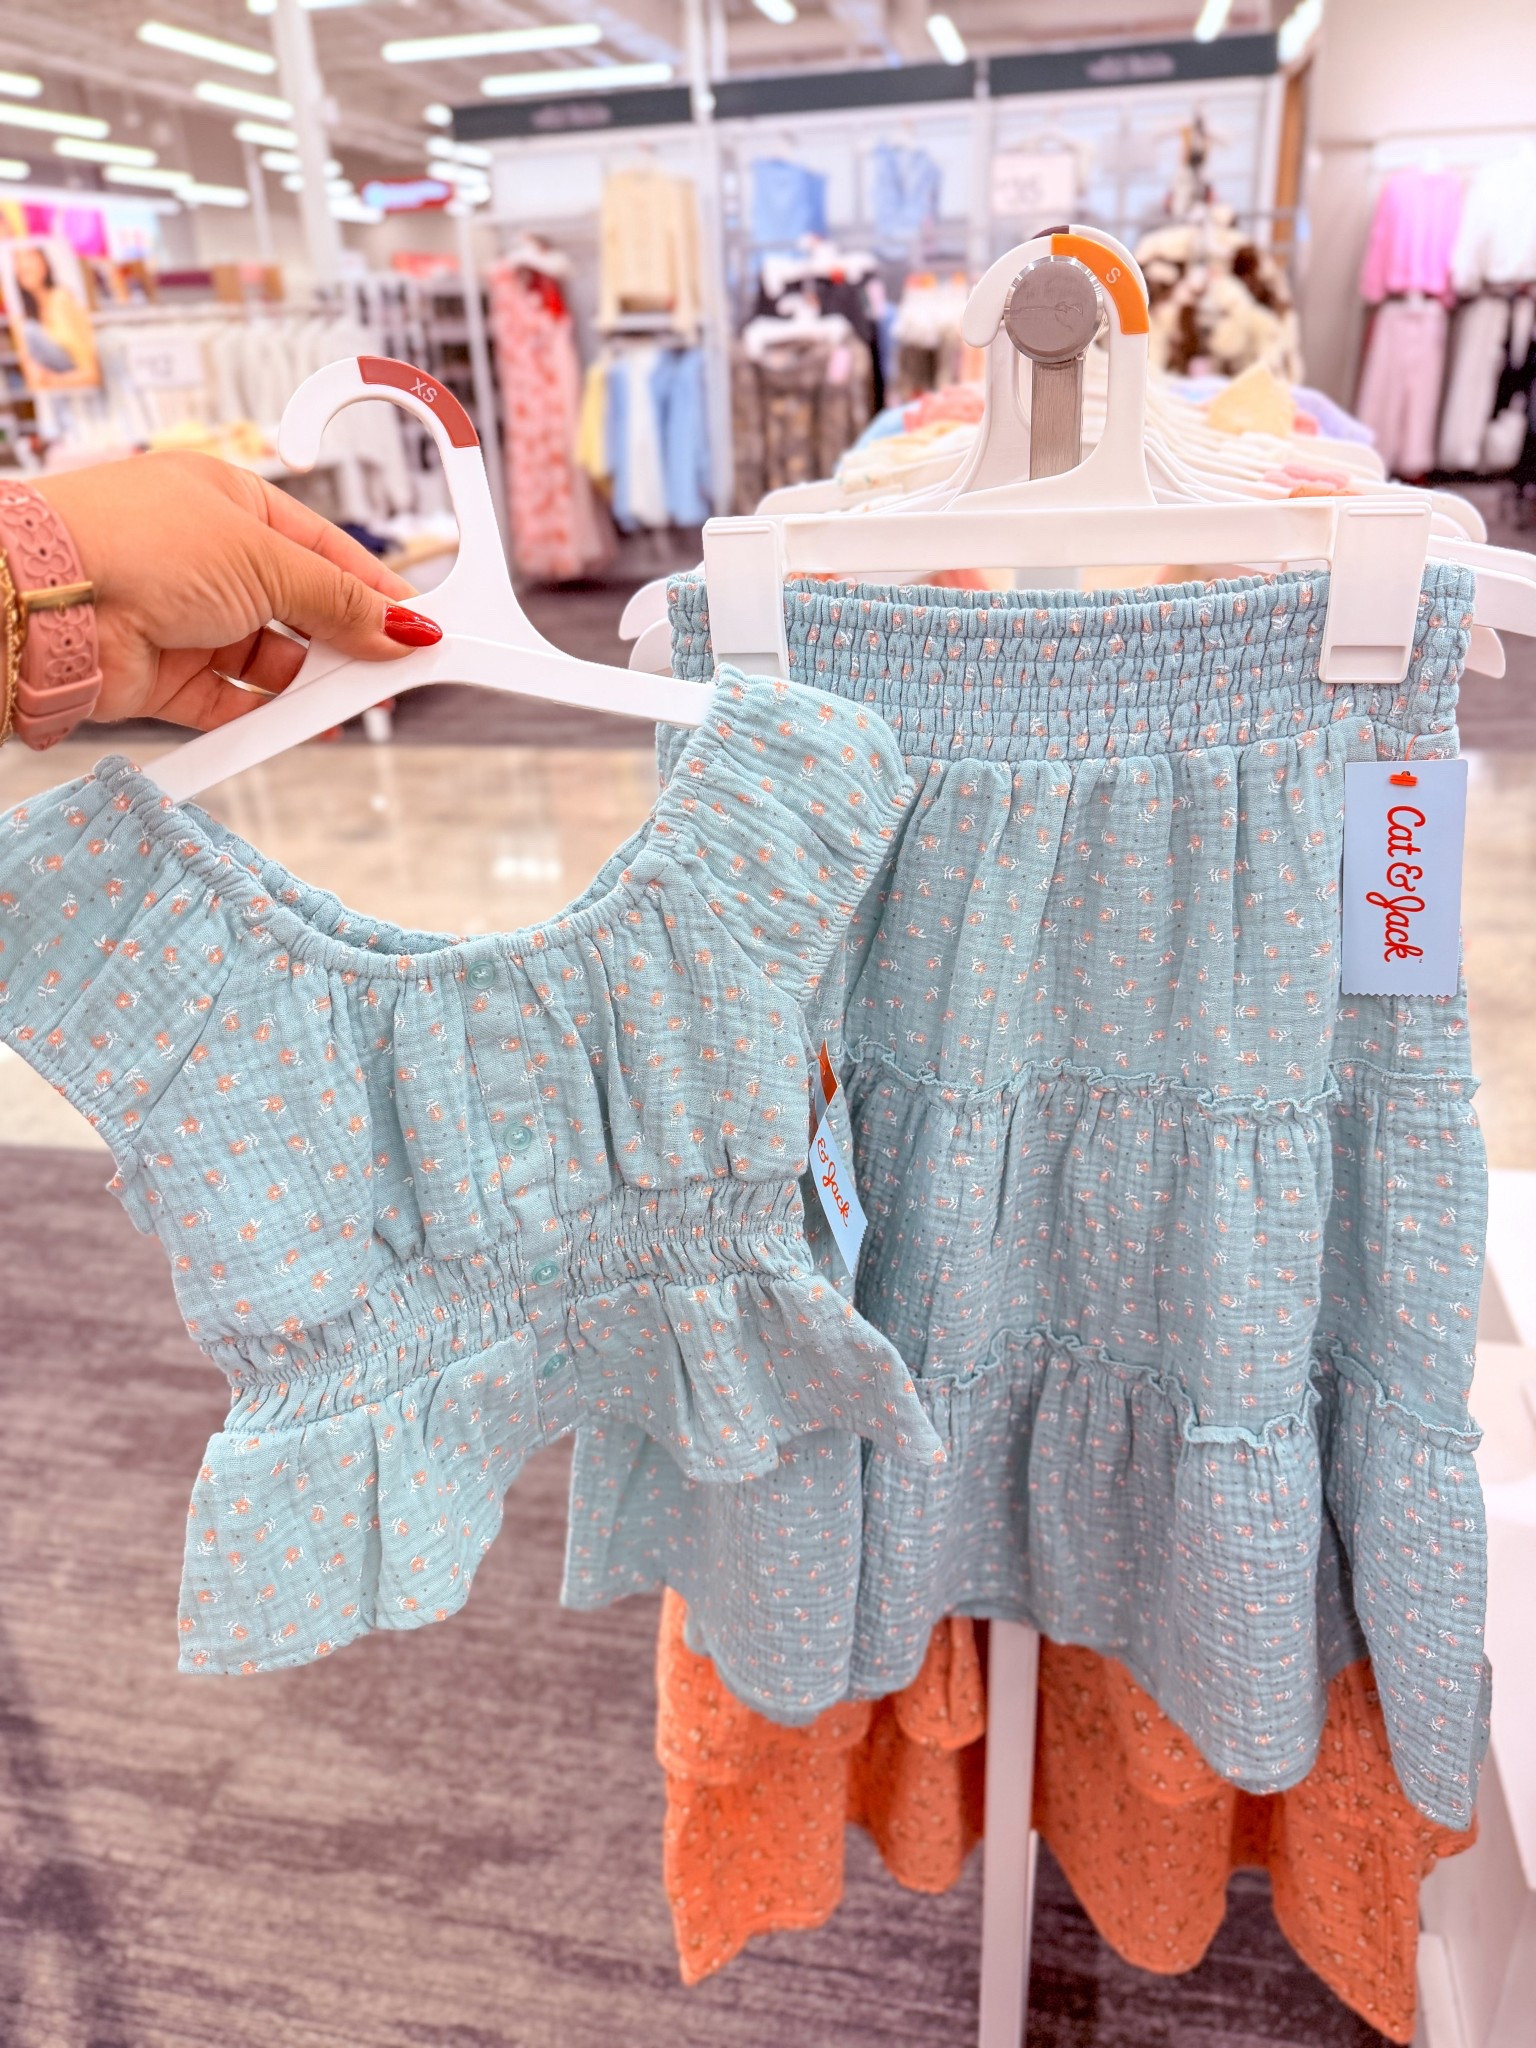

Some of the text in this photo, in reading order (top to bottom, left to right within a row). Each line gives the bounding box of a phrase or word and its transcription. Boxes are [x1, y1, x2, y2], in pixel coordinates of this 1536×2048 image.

[1105, 267, 1121, 284] S
[409, 377, 438, 403] XS
[1365, 805, 1426, 963] Cat & Jack
[817, 1136, 850, 1228] & Jack
